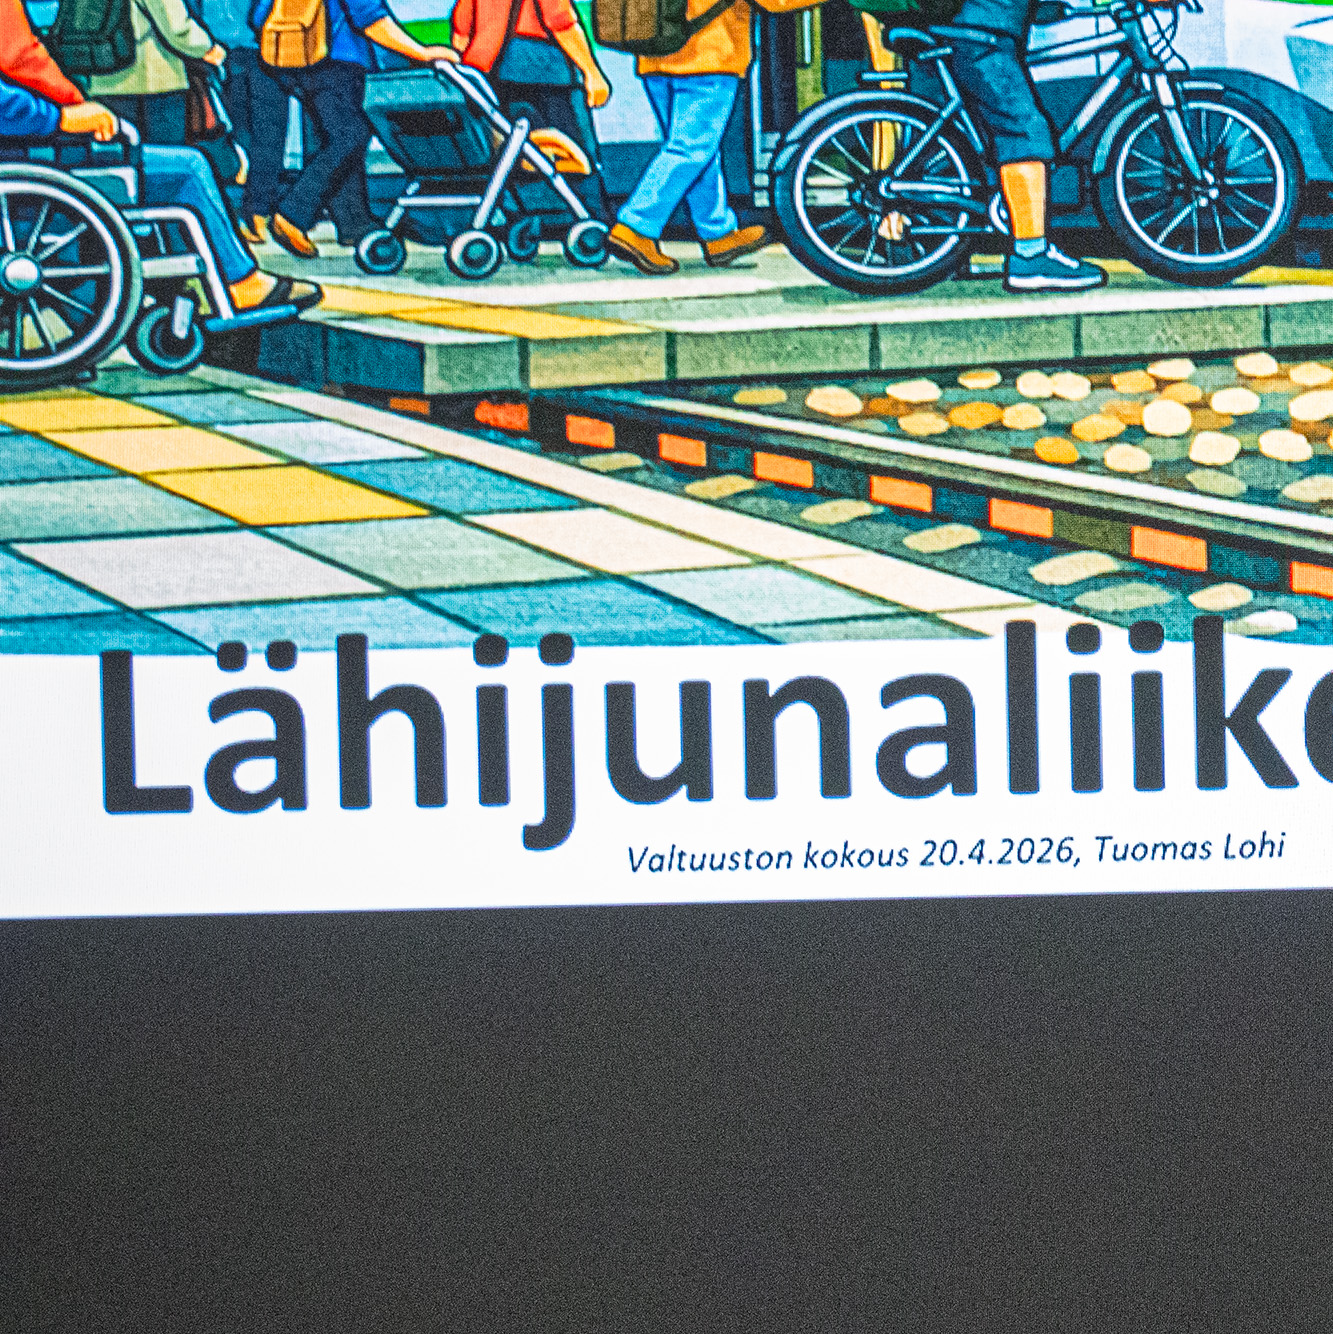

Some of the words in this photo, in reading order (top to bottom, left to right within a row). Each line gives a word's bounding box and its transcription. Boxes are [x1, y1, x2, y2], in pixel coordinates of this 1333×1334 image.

[628, 843, 793, 873] Valtuuston
[803, 839, 909, 869] kokous
[919, 836, 1082, 868] 20.4.2026,
[1094, 835, 1212, 862] Tuomas
[1223, 830, 1287, 860] Lohi
